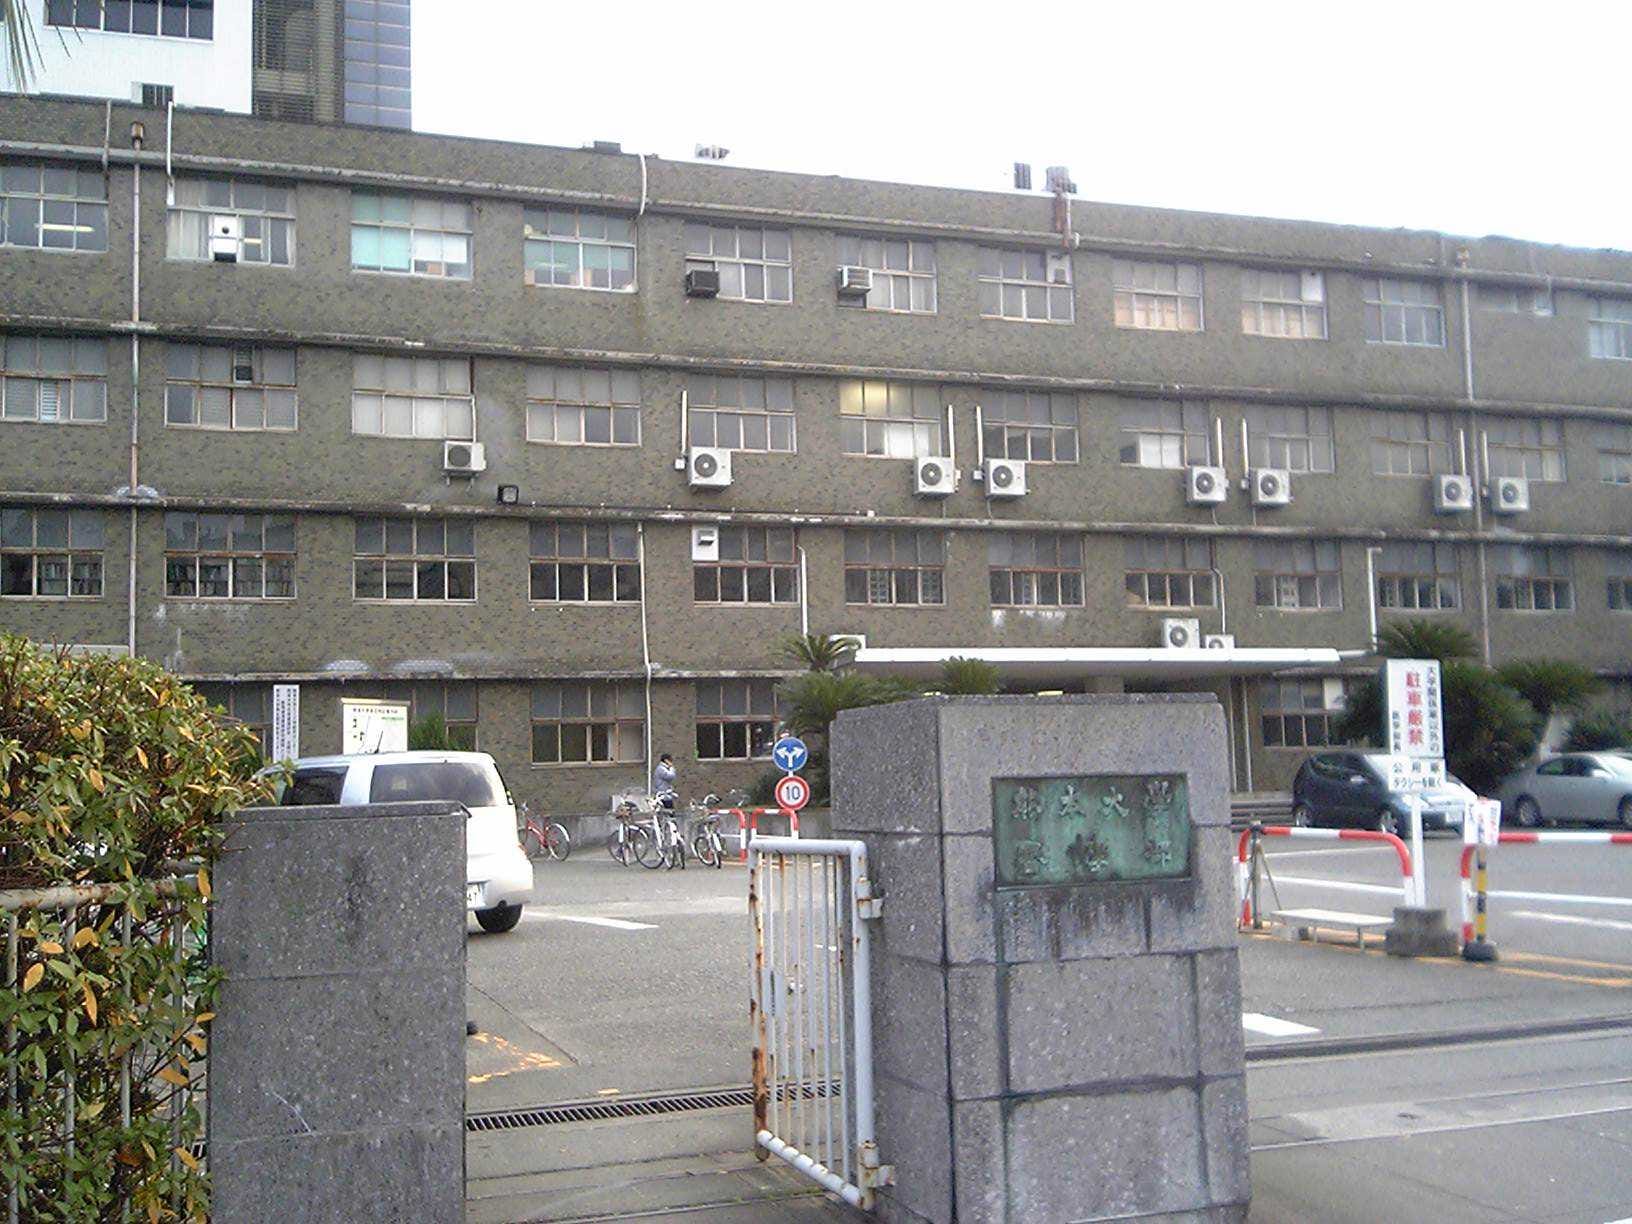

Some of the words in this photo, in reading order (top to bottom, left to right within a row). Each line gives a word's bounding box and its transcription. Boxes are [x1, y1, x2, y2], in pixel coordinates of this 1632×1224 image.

[1406, 671, 1424, 746] 駐車厳禁
[785, 785, 801, 801] 10
